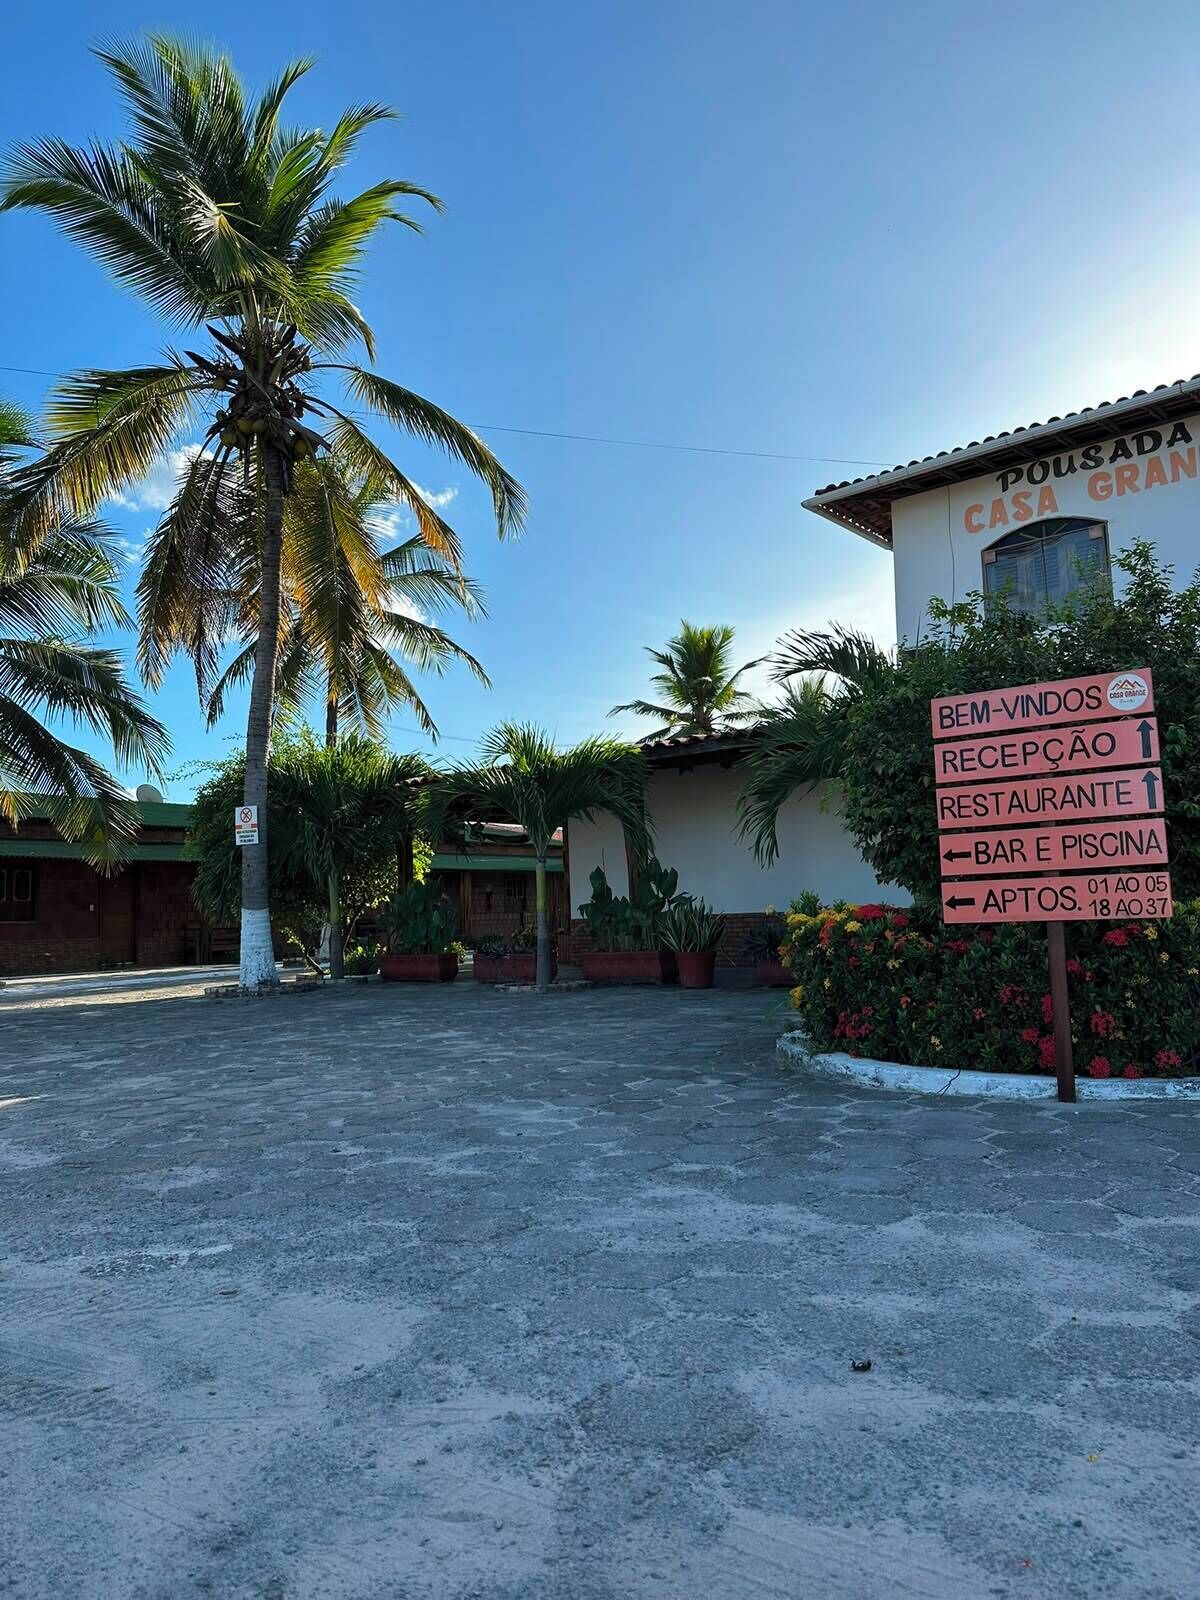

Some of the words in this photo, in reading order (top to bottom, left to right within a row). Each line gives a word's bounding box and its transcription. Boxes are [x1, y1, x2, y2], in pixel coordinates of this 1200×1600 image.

[996, 422, 1193, 493] POUSADA
[964, 485, 1059, 534] CASA
[1087, 446, 1200, 502] GRAN
[939, 685, 1102, 730] BEM-VINDOS
[942, 729, 1116, 774] RECEPÇÃO
[940, 780, 1133, 820] RESTAURANTE
[974, 838, 1027, 865] BAR
[1036, 836, 1052, 861] E
[1062, 828, 1163, 859] PISCINA
[982, 885, 1082, 913] APTOS.
[1087, 878, 1109, 895] 01
[1115, 877, 1140, 894] AO
[1145, 876, 1168, 893] 05
[1088, 900, 1111, 916] 18
[1116, 899, 1143, 916] AO
[1145, 898, 1168, 915] 37
